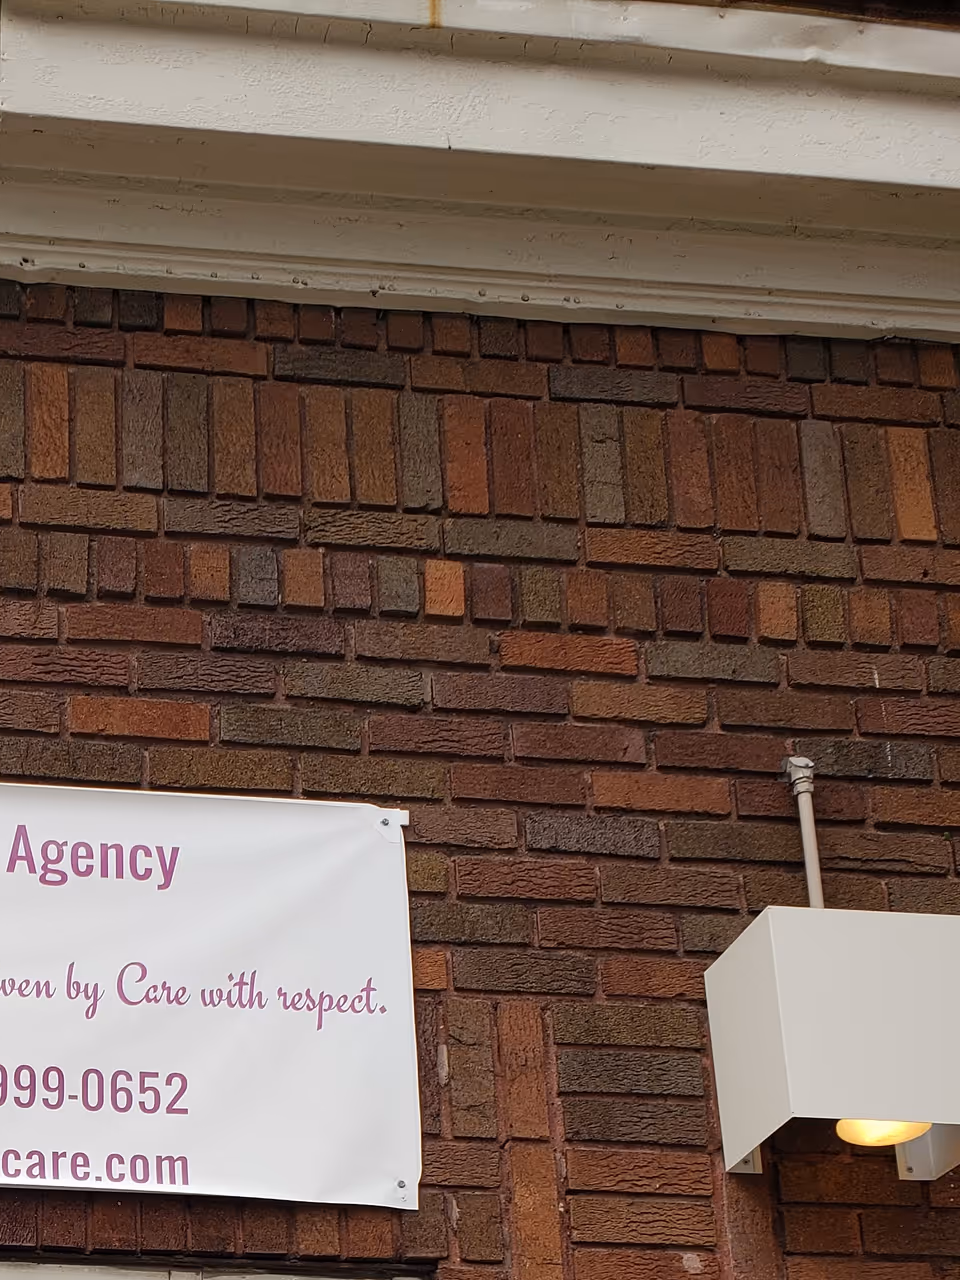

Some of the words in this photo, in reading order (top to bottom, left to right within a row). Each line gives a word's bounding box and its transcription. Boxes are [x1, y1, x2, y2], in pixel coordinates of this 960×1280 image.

[6, 824, 180, 891] Agency
[66, 961, 105, 1019] by
[116, 961, 191, 1007] Care
[200, 969, 268, 1012] with
[276, 976, 388, 1031] respect.
